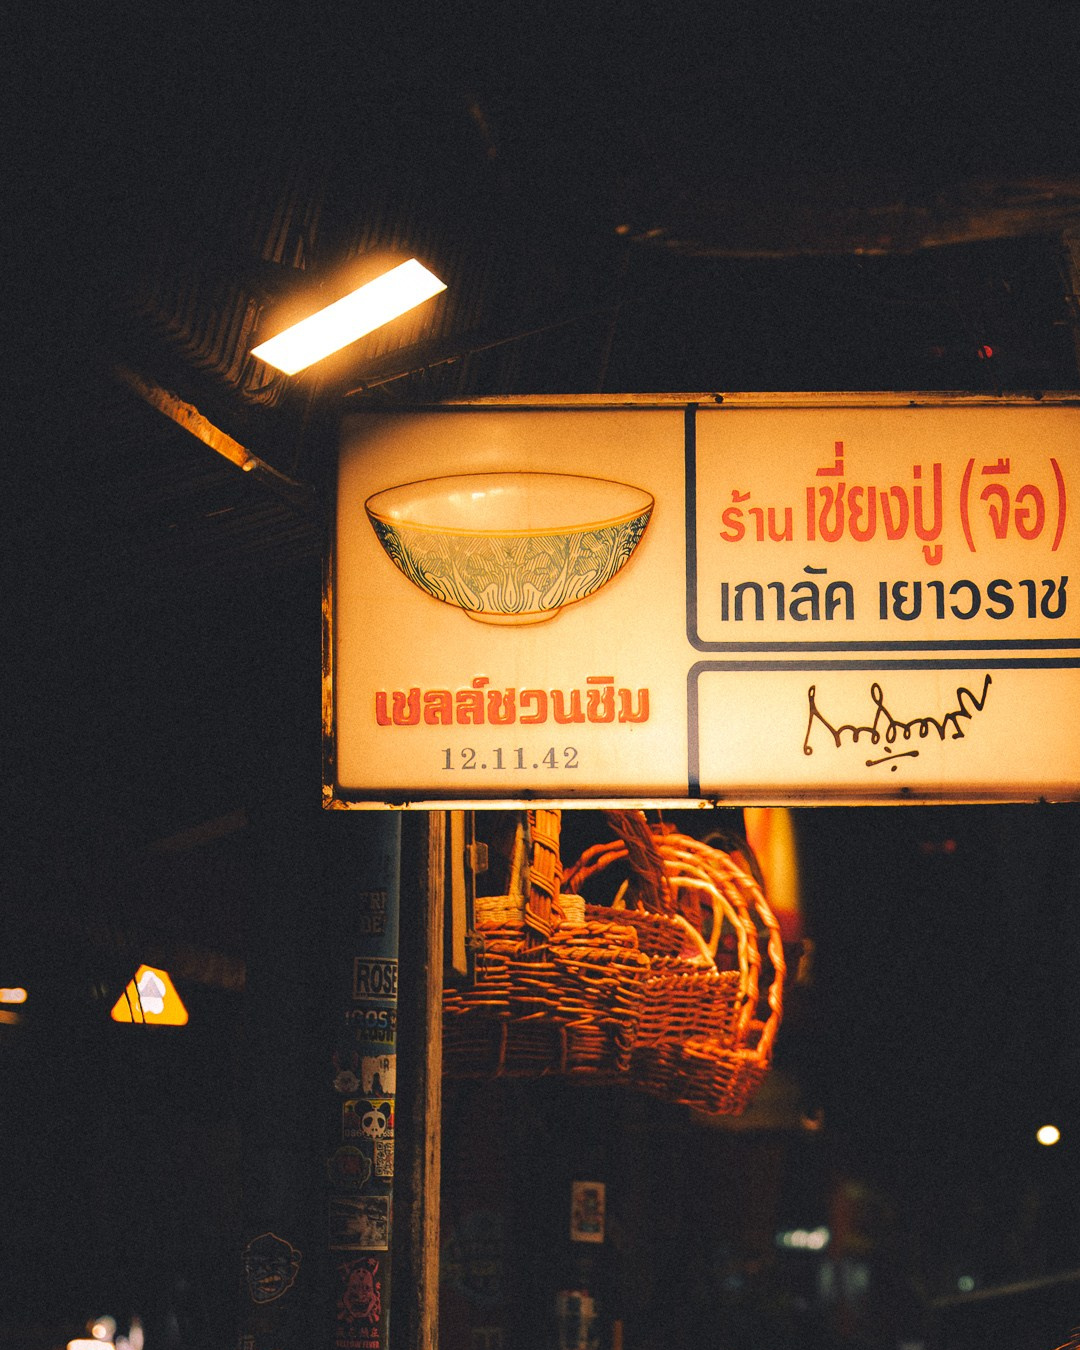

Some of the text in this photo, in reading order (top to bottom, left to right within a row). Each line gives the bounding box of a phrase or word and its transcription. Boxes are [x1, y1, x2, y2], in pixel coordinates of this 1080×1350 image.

[719, 440, 1067, 566] ร้าน เชี่ยงปู่ (จือ)
[878, 575, 1069, 621] เยาวราช
[375, 676, 650, 727] เชลล์ชวนชิม
[441, 746, 580, 771] 12.11.42
